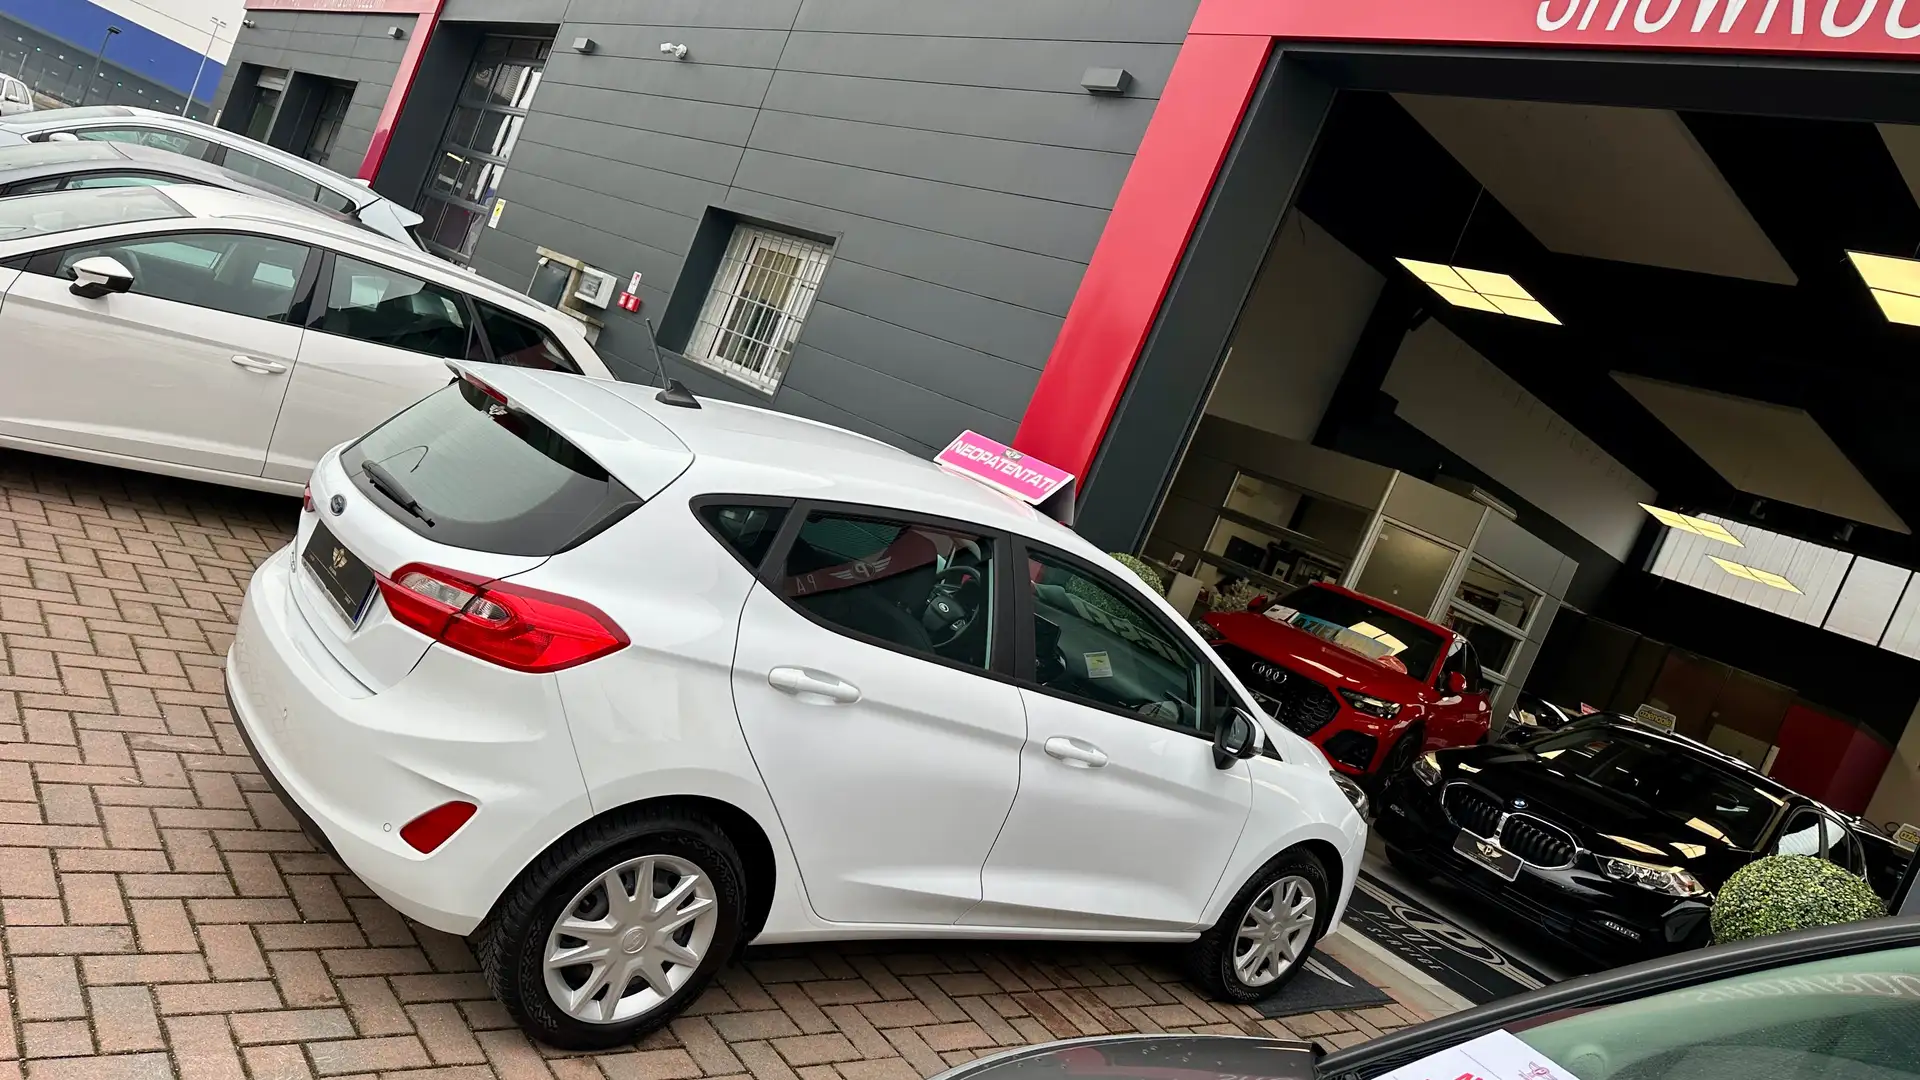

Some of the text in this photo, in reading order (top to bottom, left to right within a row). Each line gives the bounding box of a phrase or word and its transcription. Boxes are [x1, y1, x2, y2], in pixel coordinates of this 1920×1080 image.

[951, 441, 1059, 492] NEOPATENTATI
[1639, 709, 1673, 727] aziendale
[1363, 910, 1443, 952] PAUL
